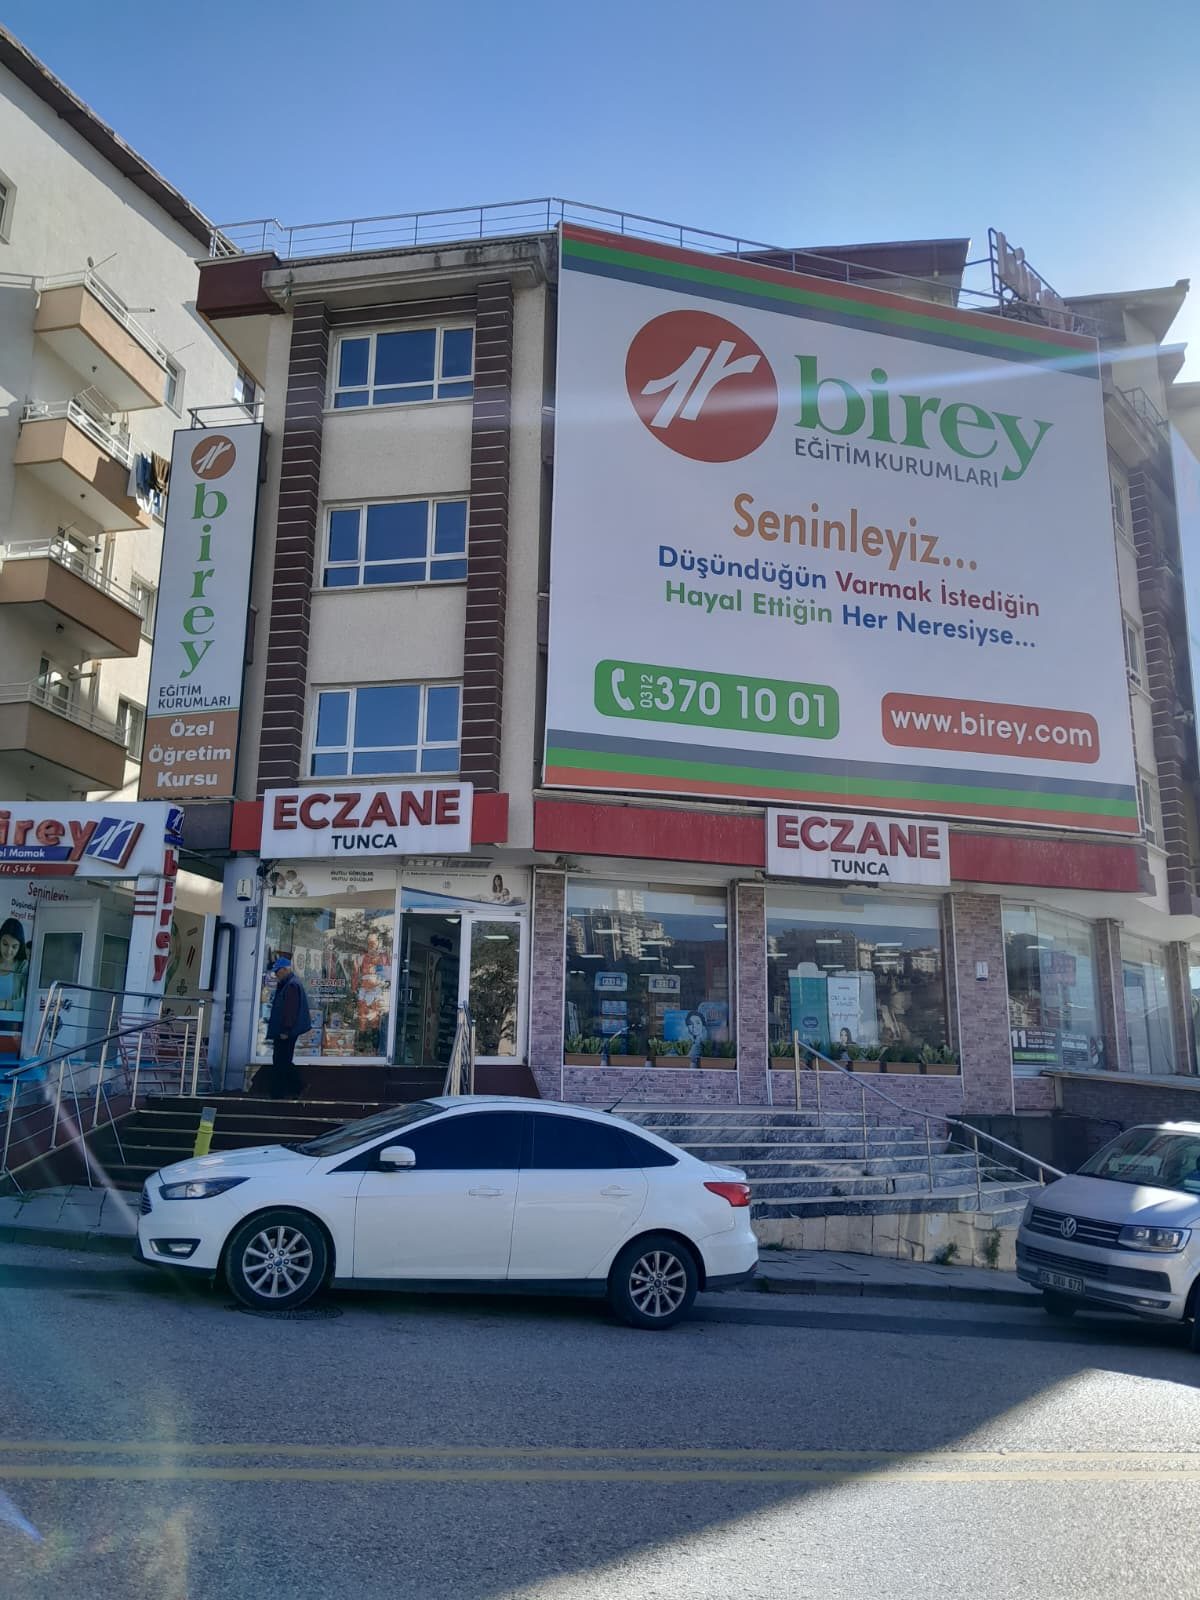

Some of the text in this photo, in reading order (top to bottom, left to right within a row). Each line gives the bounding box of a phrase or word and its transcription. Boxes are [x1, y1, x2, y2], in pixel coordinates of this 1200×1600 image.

[794, 355, 1055, 481] birey
[795, 437, 999, 489] EĞİTİM KURUMLARI
[733, 492, 977, 571] Seninleyiz...
[179, 482, 228, 679] birey
[658, 545, 1040, 619] Düşündüğün Varmak İstediğin
[666, 580, 1036, 648] Hayal Ettiğin Her Neresiyse...
[158, 696, 231, 709] KURUMLARI
[159, 684, 202, 698] EĞİTİM
[639, 674, 825, 728] 0312 370 10 01
[170, 719, 215, 737] Özel
[890, 709, 1093, 748] www.birey.com
[149, 744, 231, 766] Öğretim
[156, 772, 218, 788] Kursu
[273, 789, 461, 831] ECZANE
[331, 833, 398, 850] TUNCA
[776, 814, 941, 860] ECZANE
[831, 859, 890, 876] TUNCA
[152, 849, 178, 981] birey
